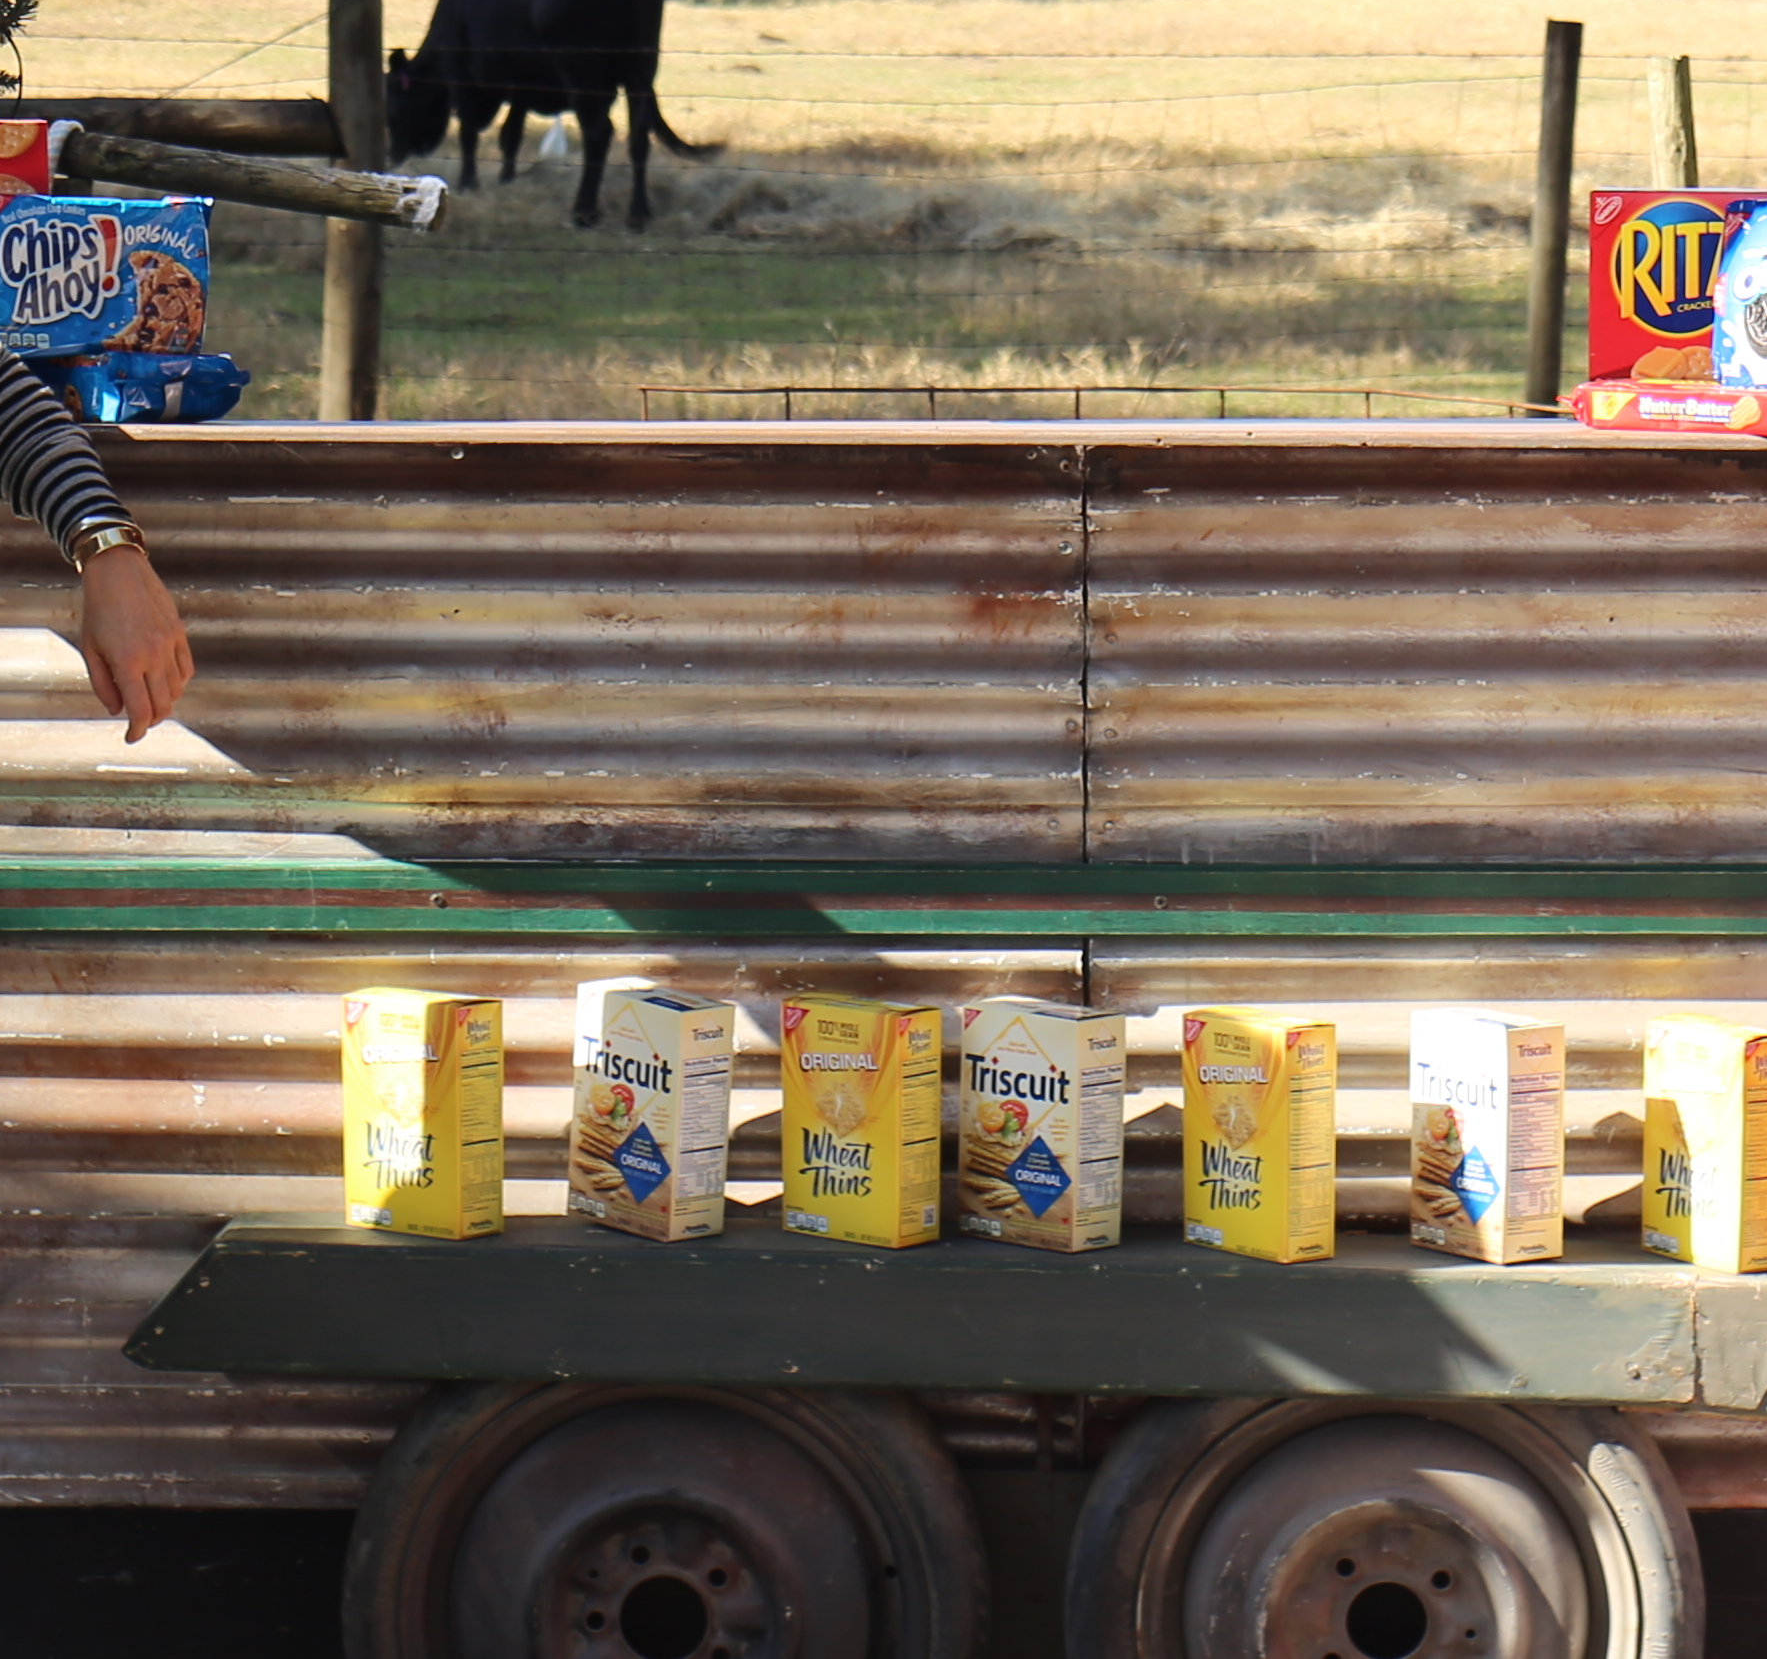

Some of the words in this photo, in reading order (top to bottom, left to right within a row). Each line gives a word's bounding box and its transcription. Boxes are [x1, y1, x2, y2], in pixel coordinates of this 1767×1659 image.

[1, 221, 99, 284] Chips
[124, 223, 197, 260] ORIGINAL
[692, 1025, 724, 1041] Triscuit
[1087, 1034, 1117, 1051] Triscuit
[582, 1035, 673, 1094] Triscuit
[800, 1052, 879, 1072] ORIGINAL
[1517, 1042, 1553, 1058] Triscuit
[965, 1053, 1070, 1105] Triscuit
[1199, 1065, 1269, 1084] ORIGINAL
[1417, 1062, 1498, 1110] Triscuit
[365, 1120, 437, 1162] Wheat
[801, 1126, 874, 1170] Wheat
[362, 1158, 434, 1189] Thins
[620, 1153, 663, 1175] ORIGINAL
[1200, 1139, 1264, 1184] Wheat
[798, 1165, 872, 1198] Thins
[1014, 1169, 1062, 1187] ORIGINAL
[1198, 1178, 1262, 1210] Thins
